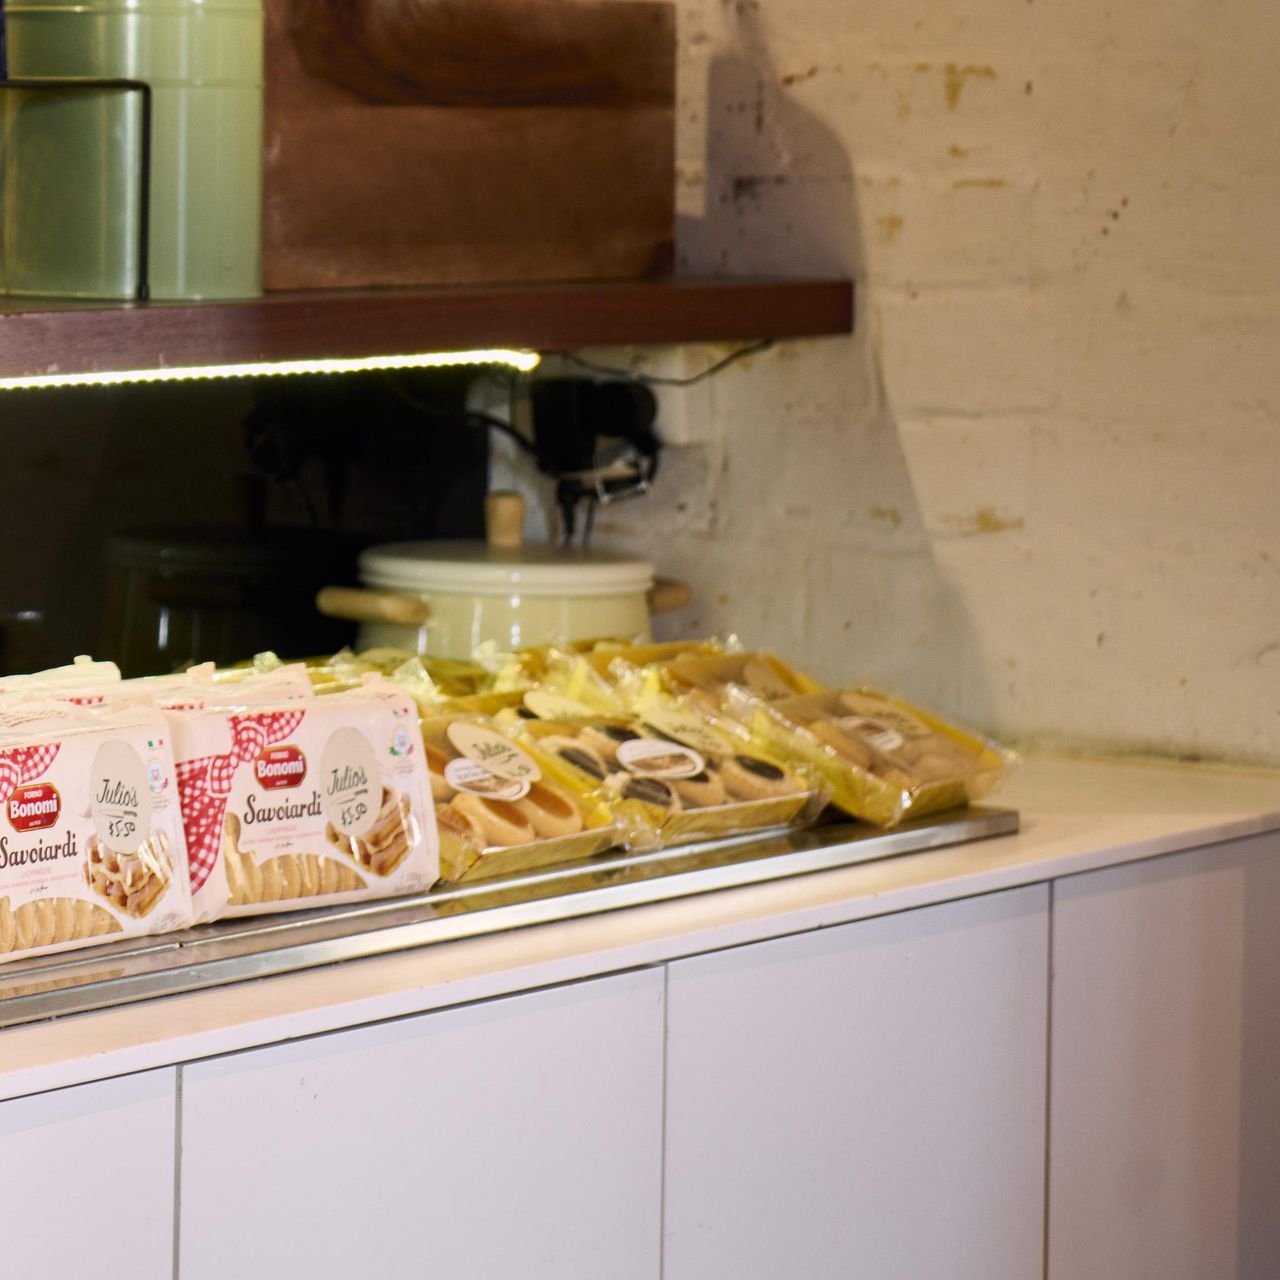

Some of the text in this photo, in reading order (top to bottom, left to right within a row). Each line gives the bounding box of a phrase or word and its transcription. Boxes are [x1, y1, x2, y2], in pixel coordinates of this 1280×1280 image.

[256, 754, 305, 777] Bonomi
[95, 778, 140, 810] Julio's
[326, 765, 369, 796] Julio's
[9, 793, 58, 819] Bonomi
[242, 790, 323, 826] Savoiardi
[108, 820, 137, 839] $5.50
